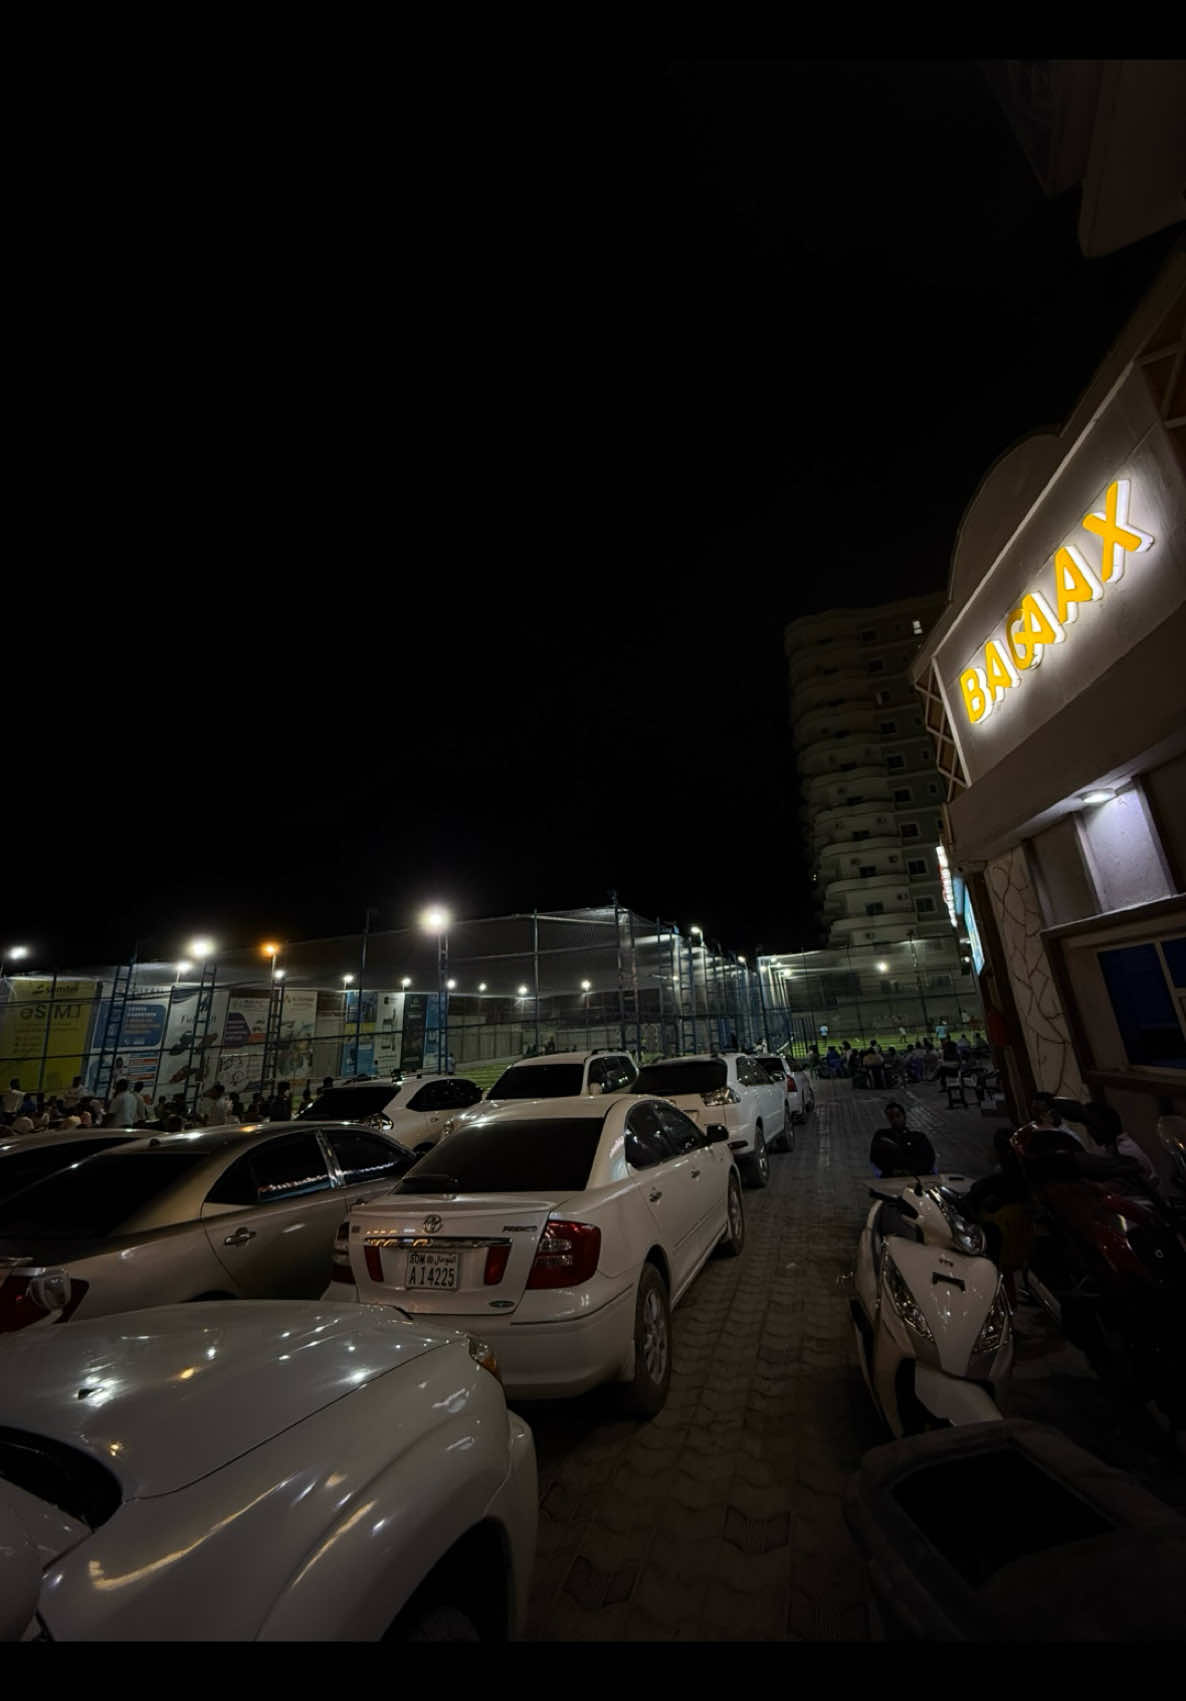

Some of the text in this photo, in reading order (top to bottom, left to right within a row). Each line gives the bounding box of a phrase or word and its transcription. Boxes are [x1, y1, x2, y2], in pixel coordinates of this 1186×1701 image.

[960, 480, 1152, 725] BAGAAX
[20, 1004, 71, 1020] eSM
[410, 1266, 454, 1287] A 14225
